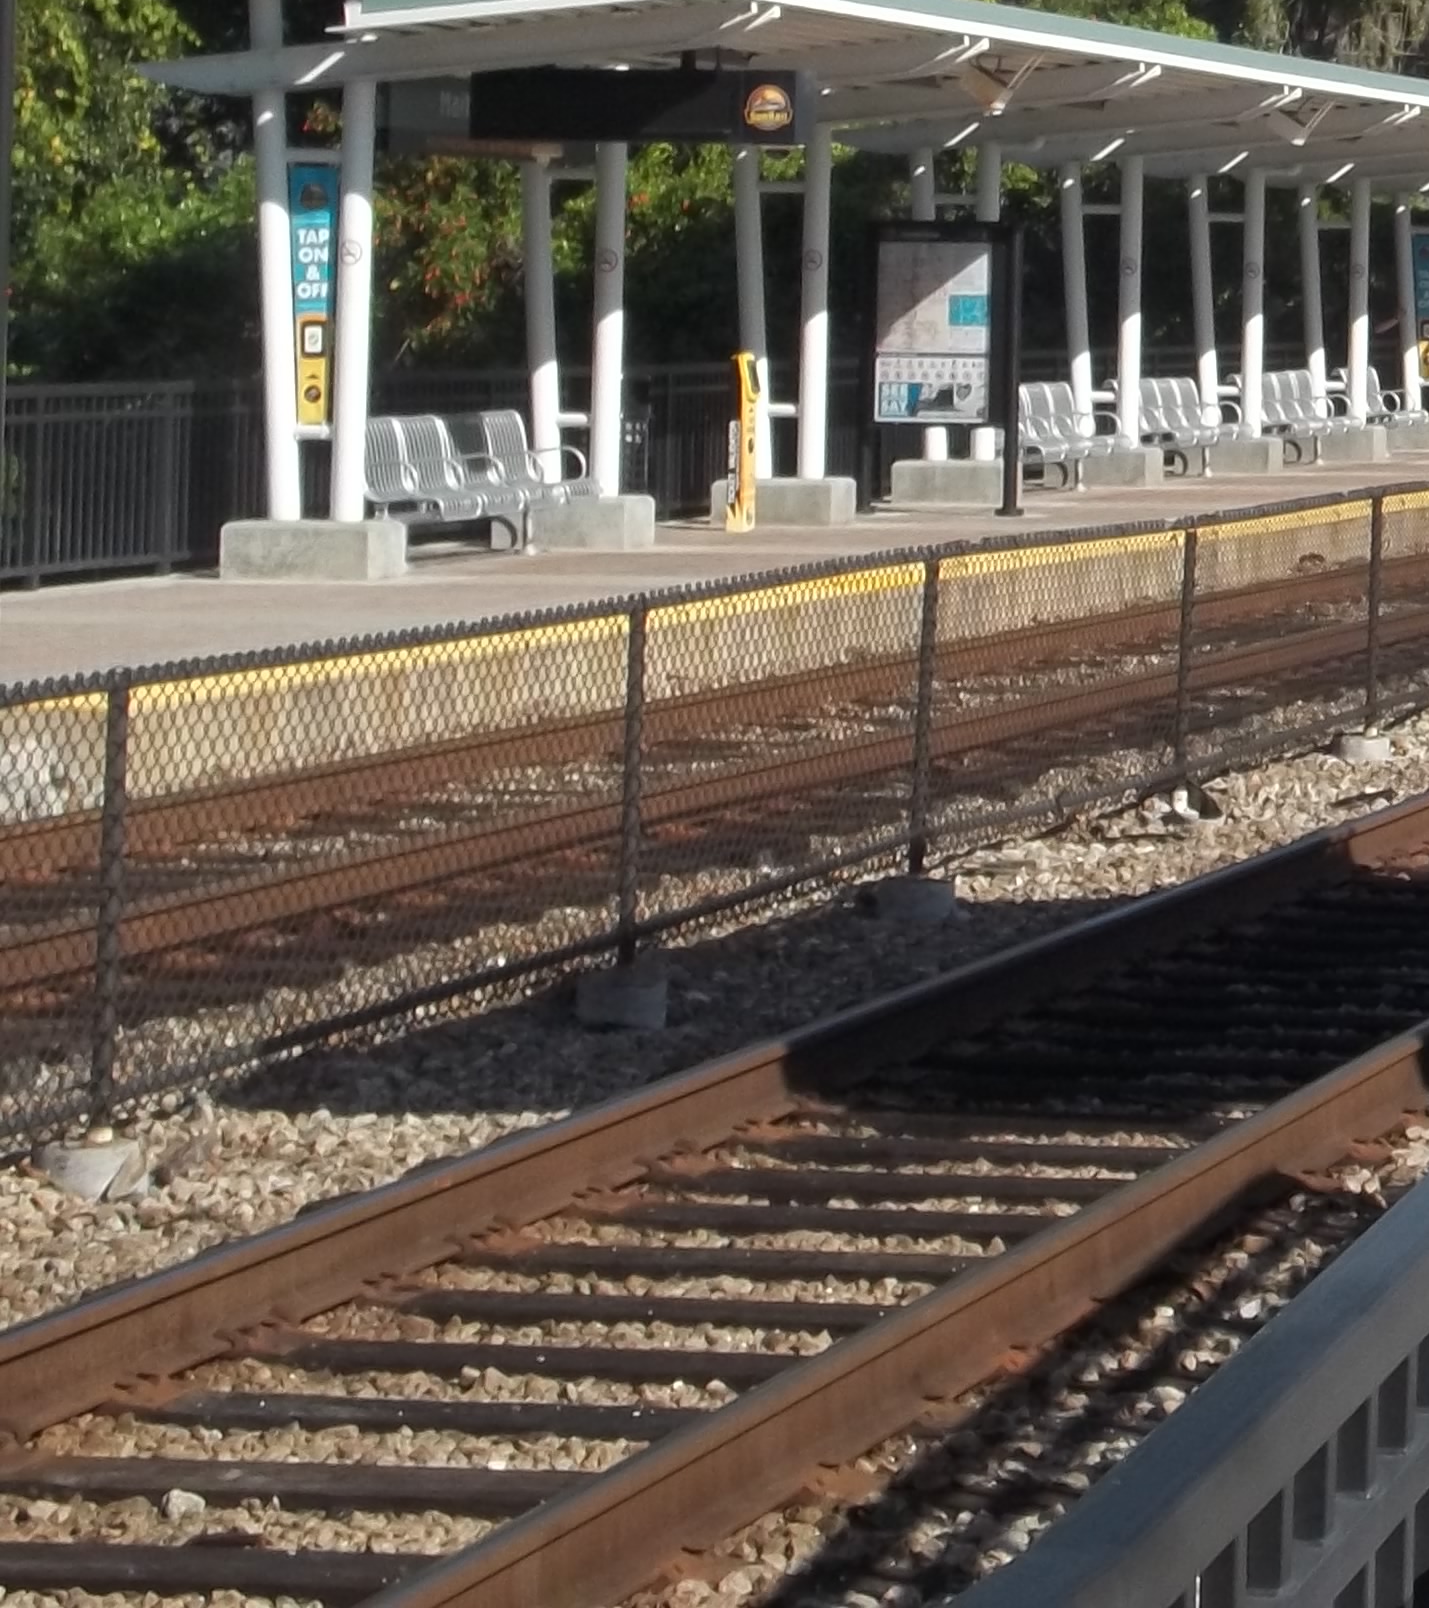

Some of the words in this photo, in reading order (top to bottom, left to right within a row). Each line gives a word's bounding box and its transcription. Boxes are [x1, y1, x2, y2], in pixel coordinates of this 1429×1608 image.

[297, 228, 330, 245] TAP
[298, 247, 329, 263] ON
[306, 264, 320, 281] &
